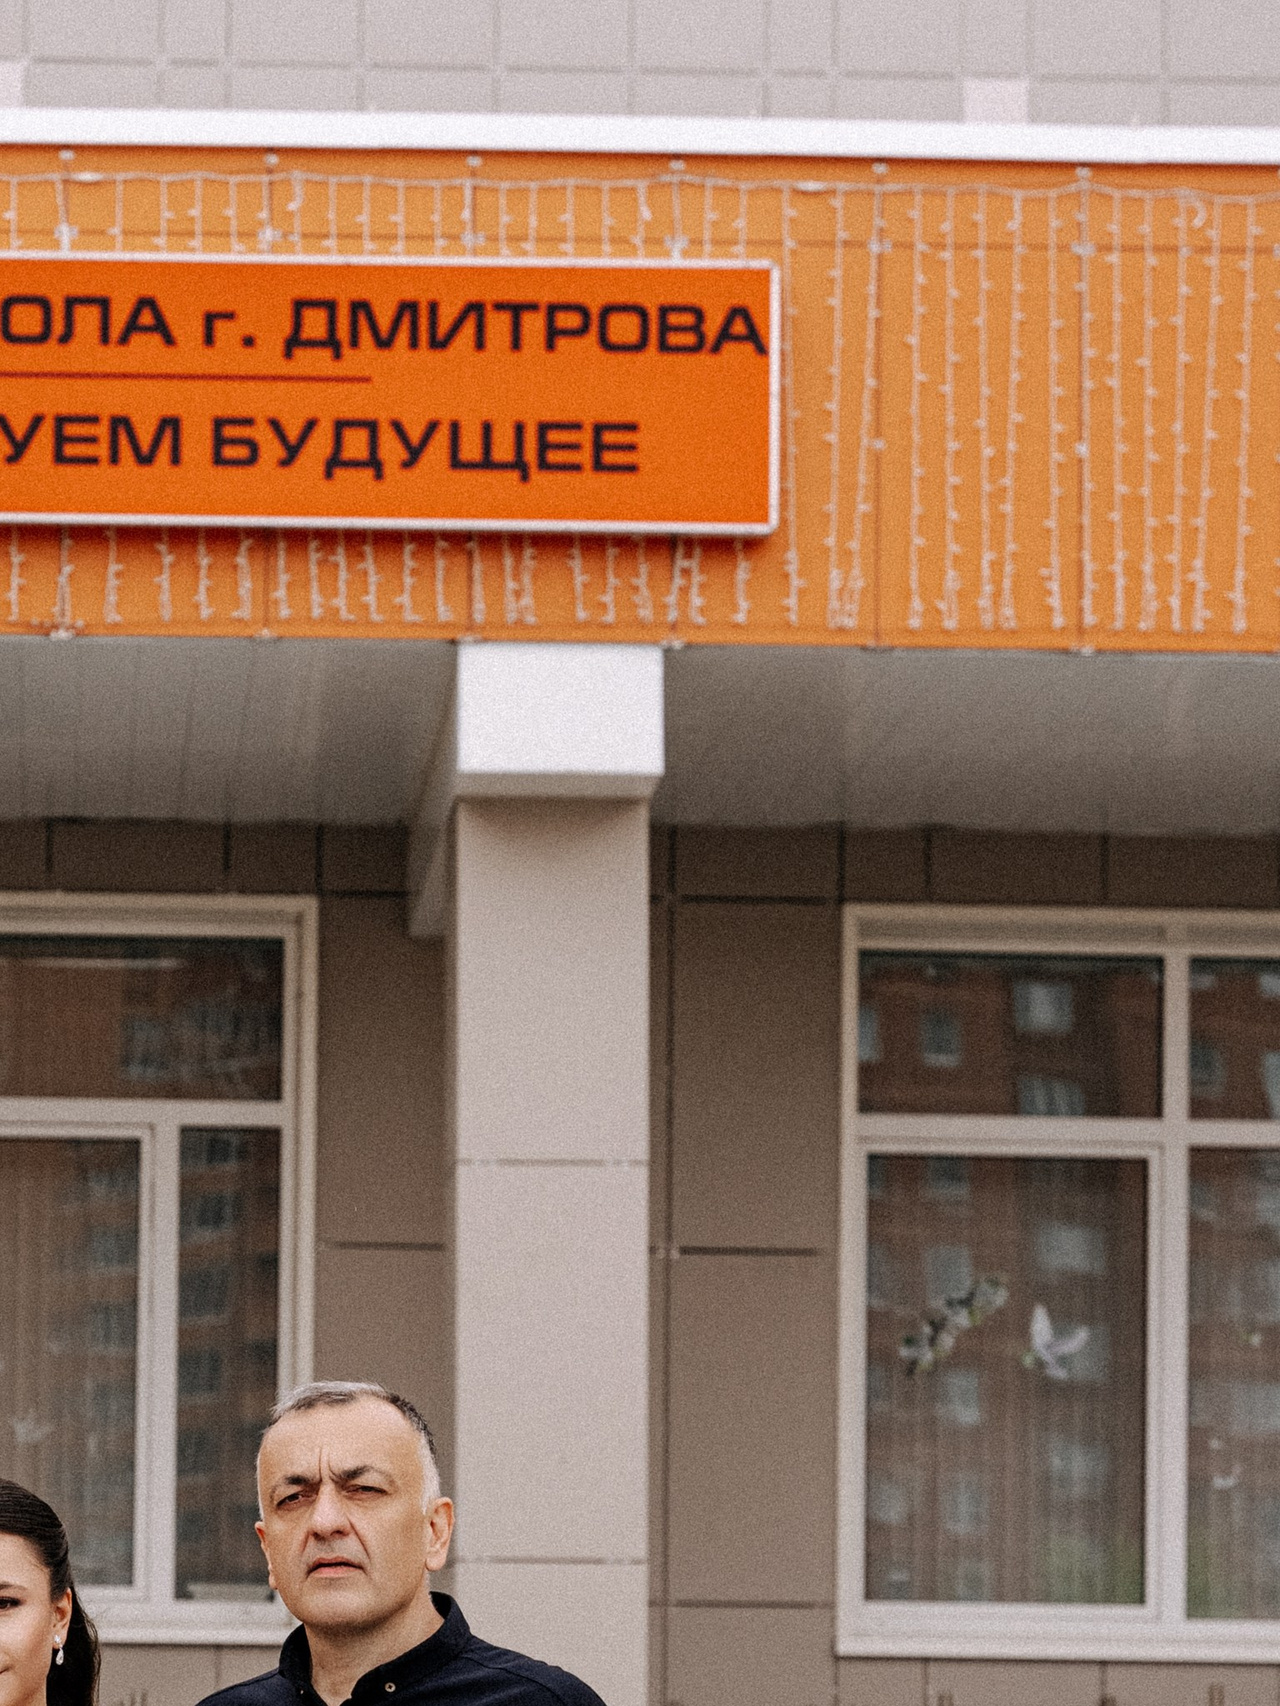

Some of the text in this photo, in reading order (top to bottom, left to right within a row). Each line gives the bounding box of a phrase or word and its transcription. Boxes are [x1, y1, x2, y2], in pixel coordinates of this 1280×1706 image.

[203, 310, 255, 348] г.
[283, 298, 768, 360] ДМИТРОВА
[212, 416, 639, 481] БУДУЩЕЕ
